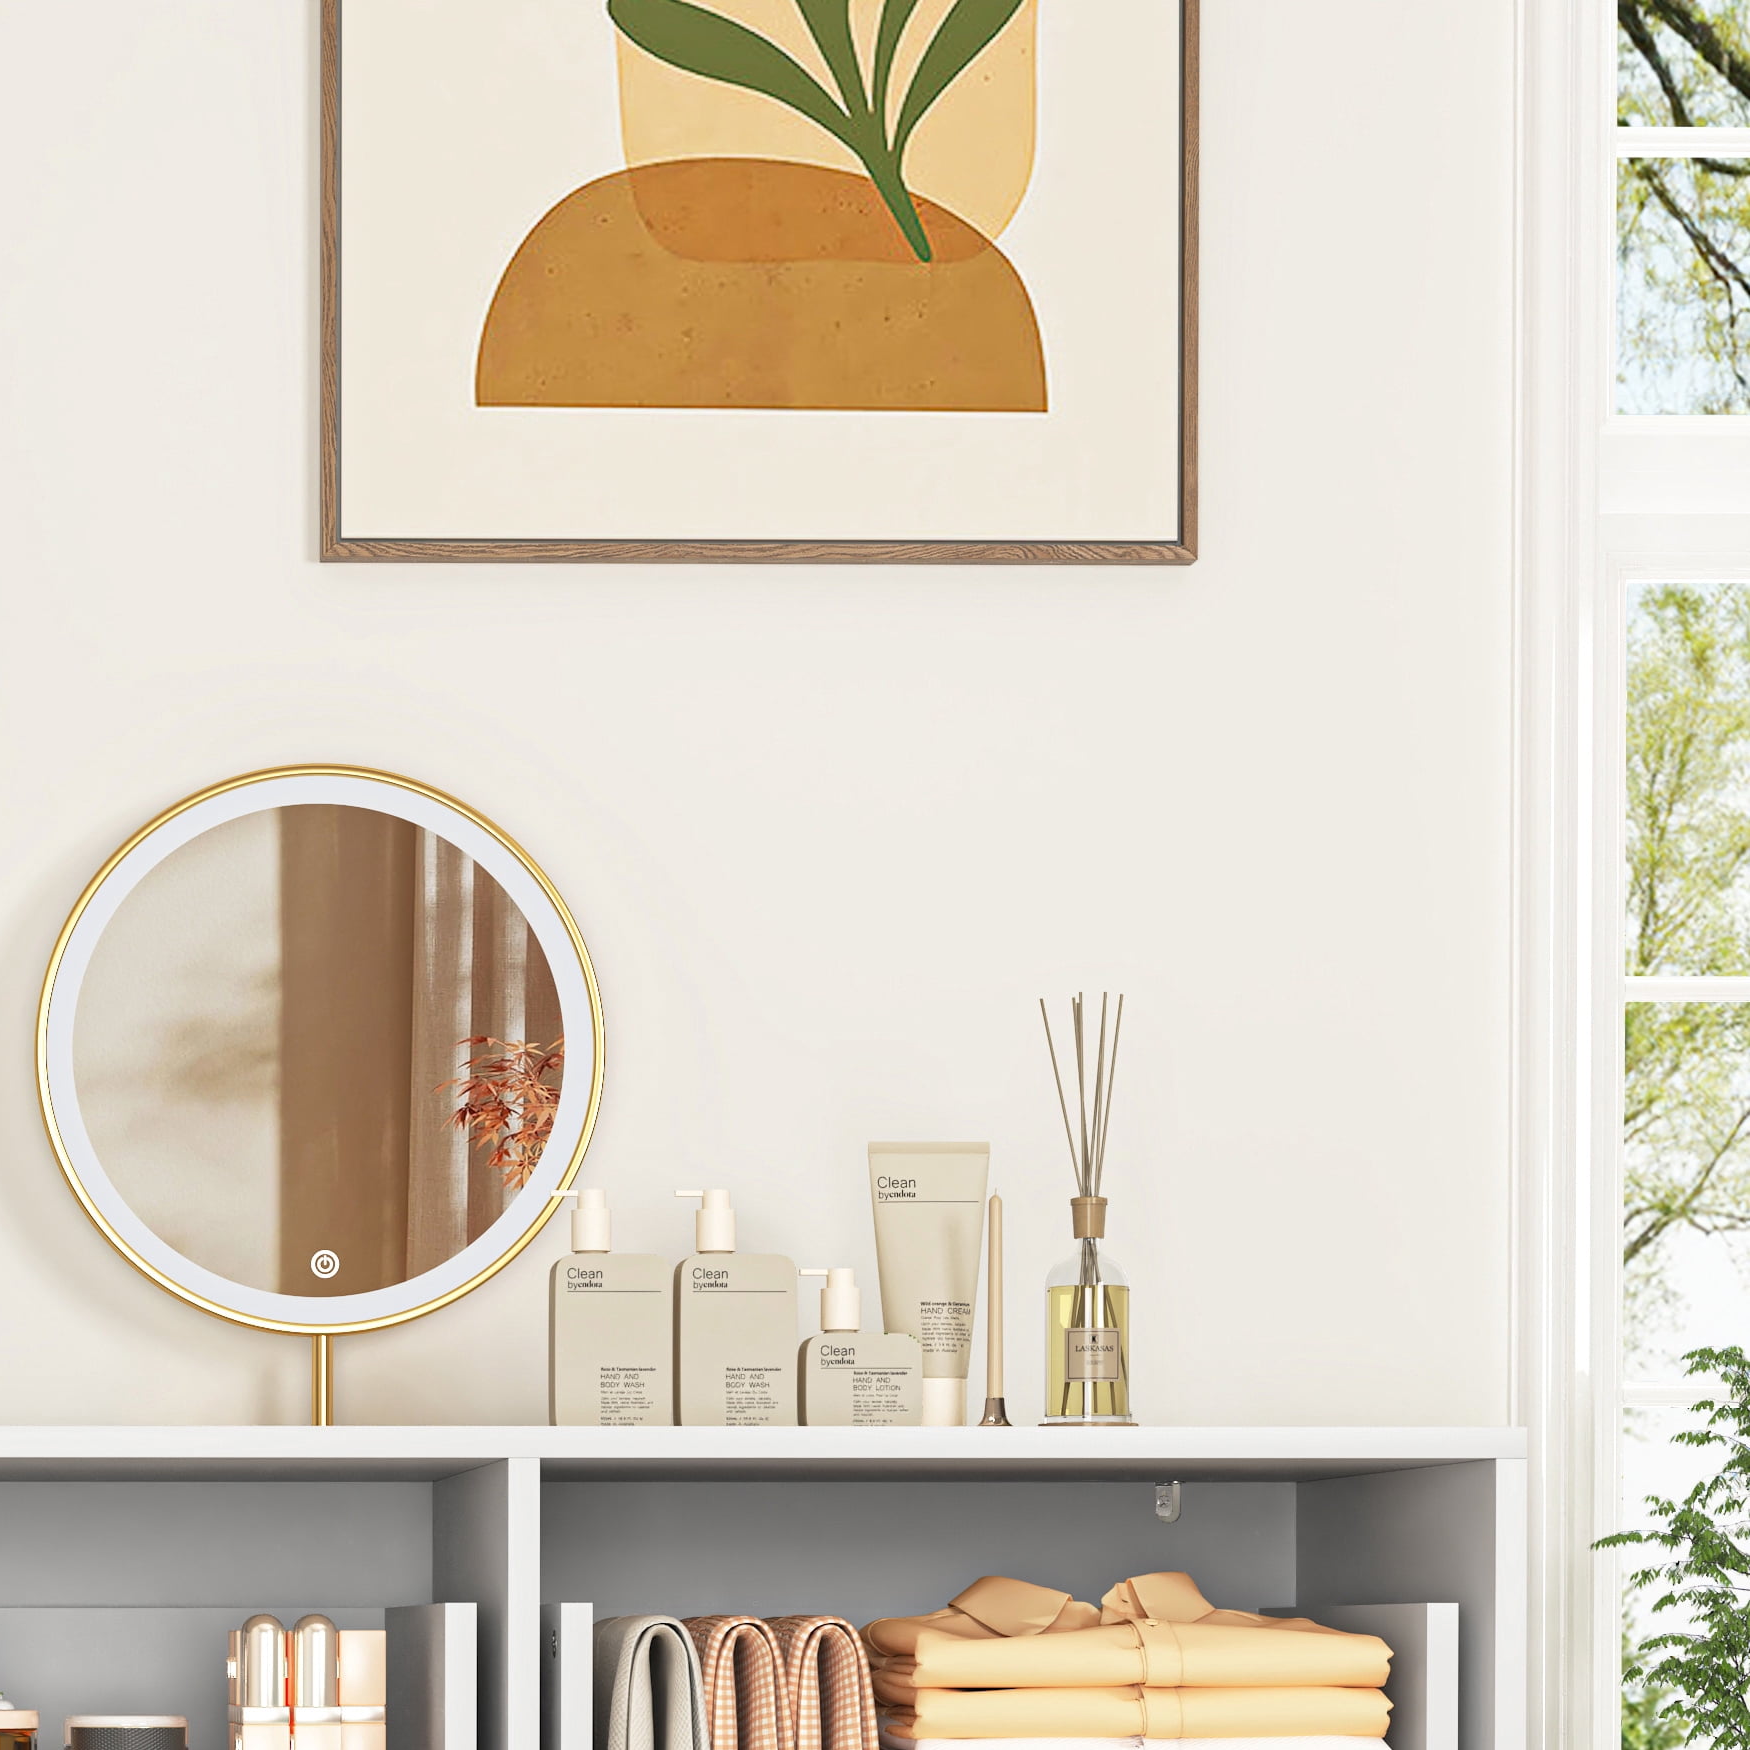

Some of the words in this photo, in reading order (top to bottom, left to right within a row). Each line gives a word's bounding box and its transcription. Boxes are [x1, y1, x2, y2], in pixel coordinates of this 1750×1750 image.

[877, 1176, 917, 1189] Clean
[567, 1267, 603, 1280] Clean
[692, 1267, 729, 1280] Clean
[820, 1344, 856, 1357] Clean
